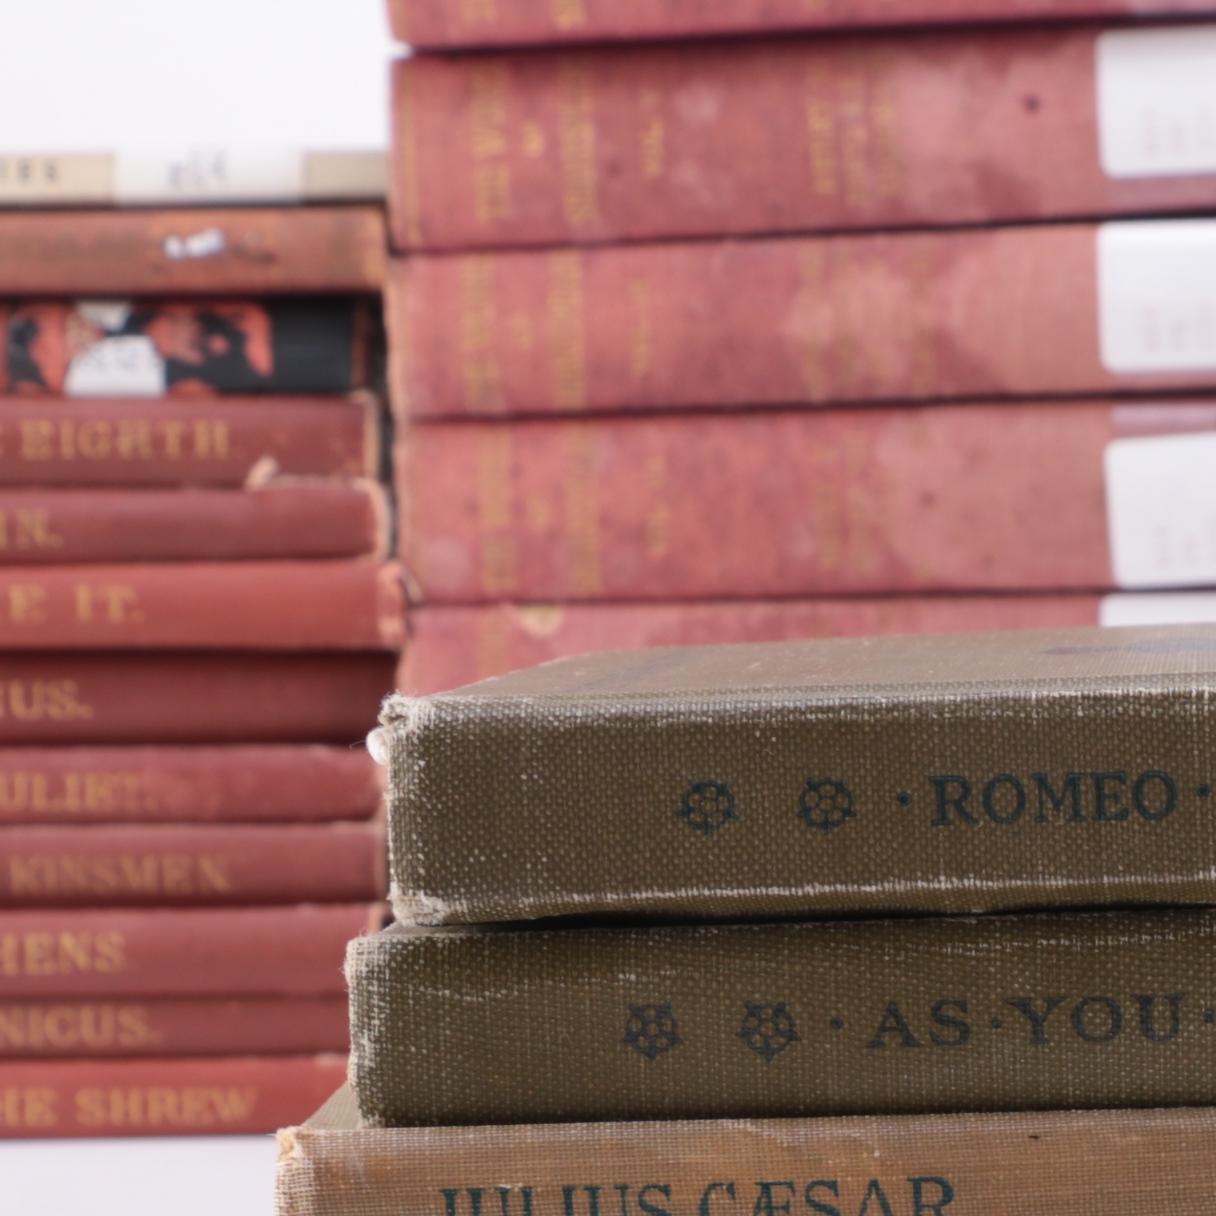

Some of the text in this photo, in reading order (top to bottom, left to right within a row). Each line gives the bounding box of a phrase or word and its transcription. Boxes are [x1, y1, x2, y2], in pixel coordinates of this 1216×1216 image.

[0, 678, 94, 720] US.
[929, 768, 1180, 828] ROMEO
[865, 997, 972, 1049] AS
[1003, 992, 1185, 1046] YOU
